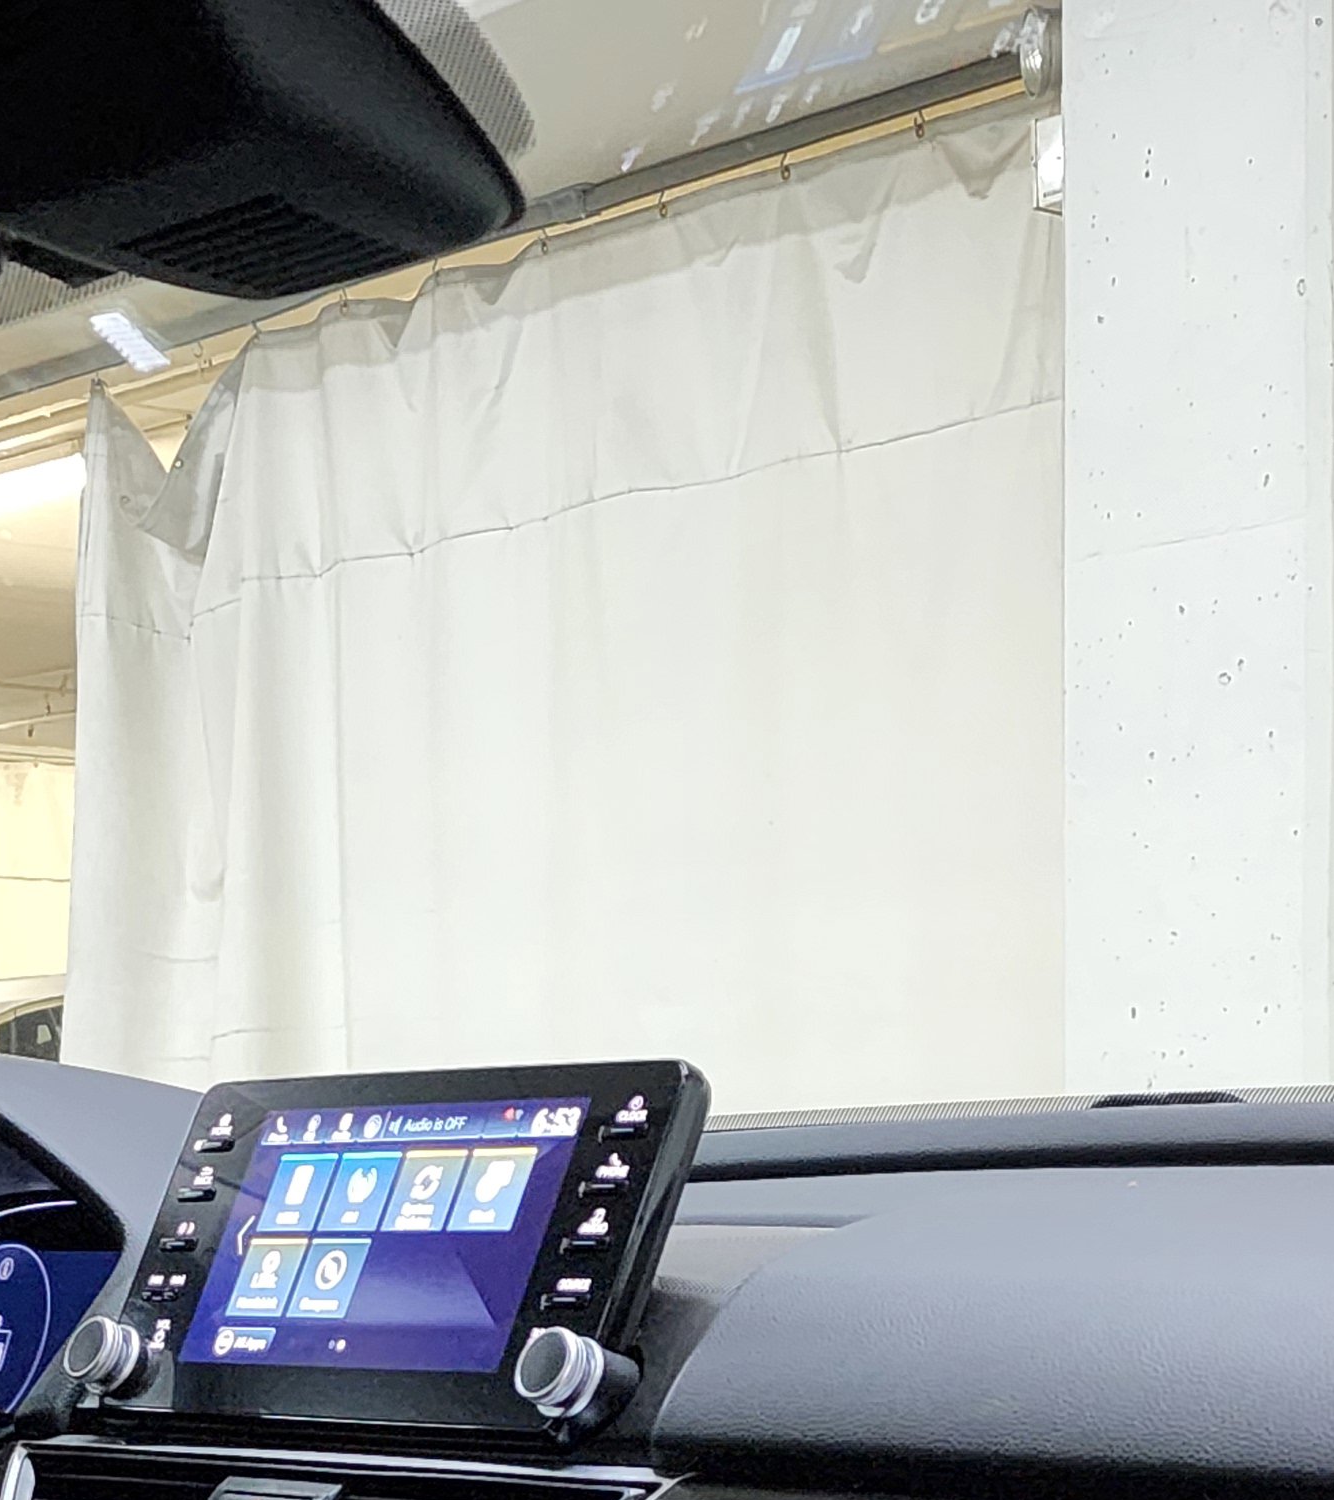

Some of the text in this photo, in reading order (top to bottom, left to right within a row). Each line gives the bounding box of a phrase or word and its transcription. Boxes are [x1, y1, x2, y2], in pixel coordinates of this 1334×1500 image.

[403, 1115, 468, 1132] Audio is OFF
[615, 1109, 648, 1123] CLOCK
